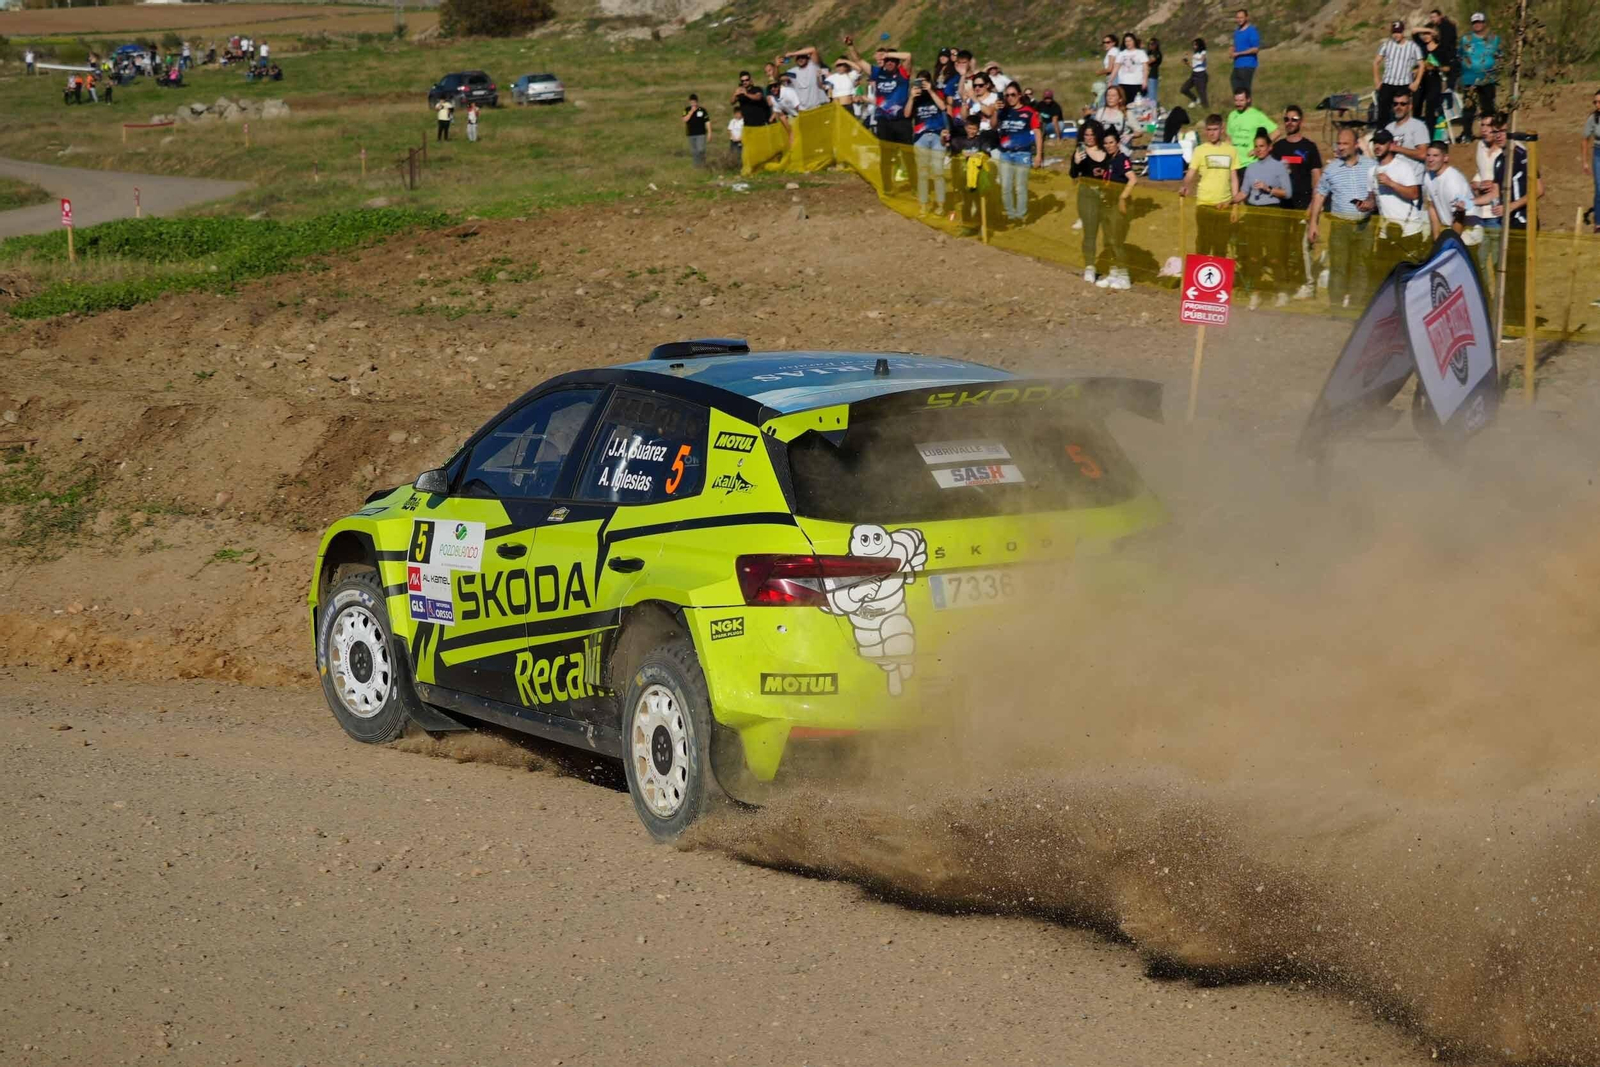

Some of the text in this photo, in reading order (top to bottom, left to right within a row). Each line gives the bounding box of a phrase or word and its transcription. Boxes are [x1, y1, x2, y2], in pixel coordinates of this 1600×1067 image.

[1184, 310, 1225, 321] PÚBLICO
[608, 437, 668, 462] J.A. Suárez
[716, 434, 754, 450] MOTUL
[922, 445, 984, 457] LUBRIVALLE
[665, 444, 692, 495] 5
[1064, 444, 1101, 479] 5
[598, 467, 653, 492] A. Iglesias
[951, 465, 1005, 482] SASH
[415, 523, 429, 562] 5
[948, 573, 1015, 603] 7336
[712, 618, 743, 634] NGK
[764, 676, 836, 692] MOTUL
